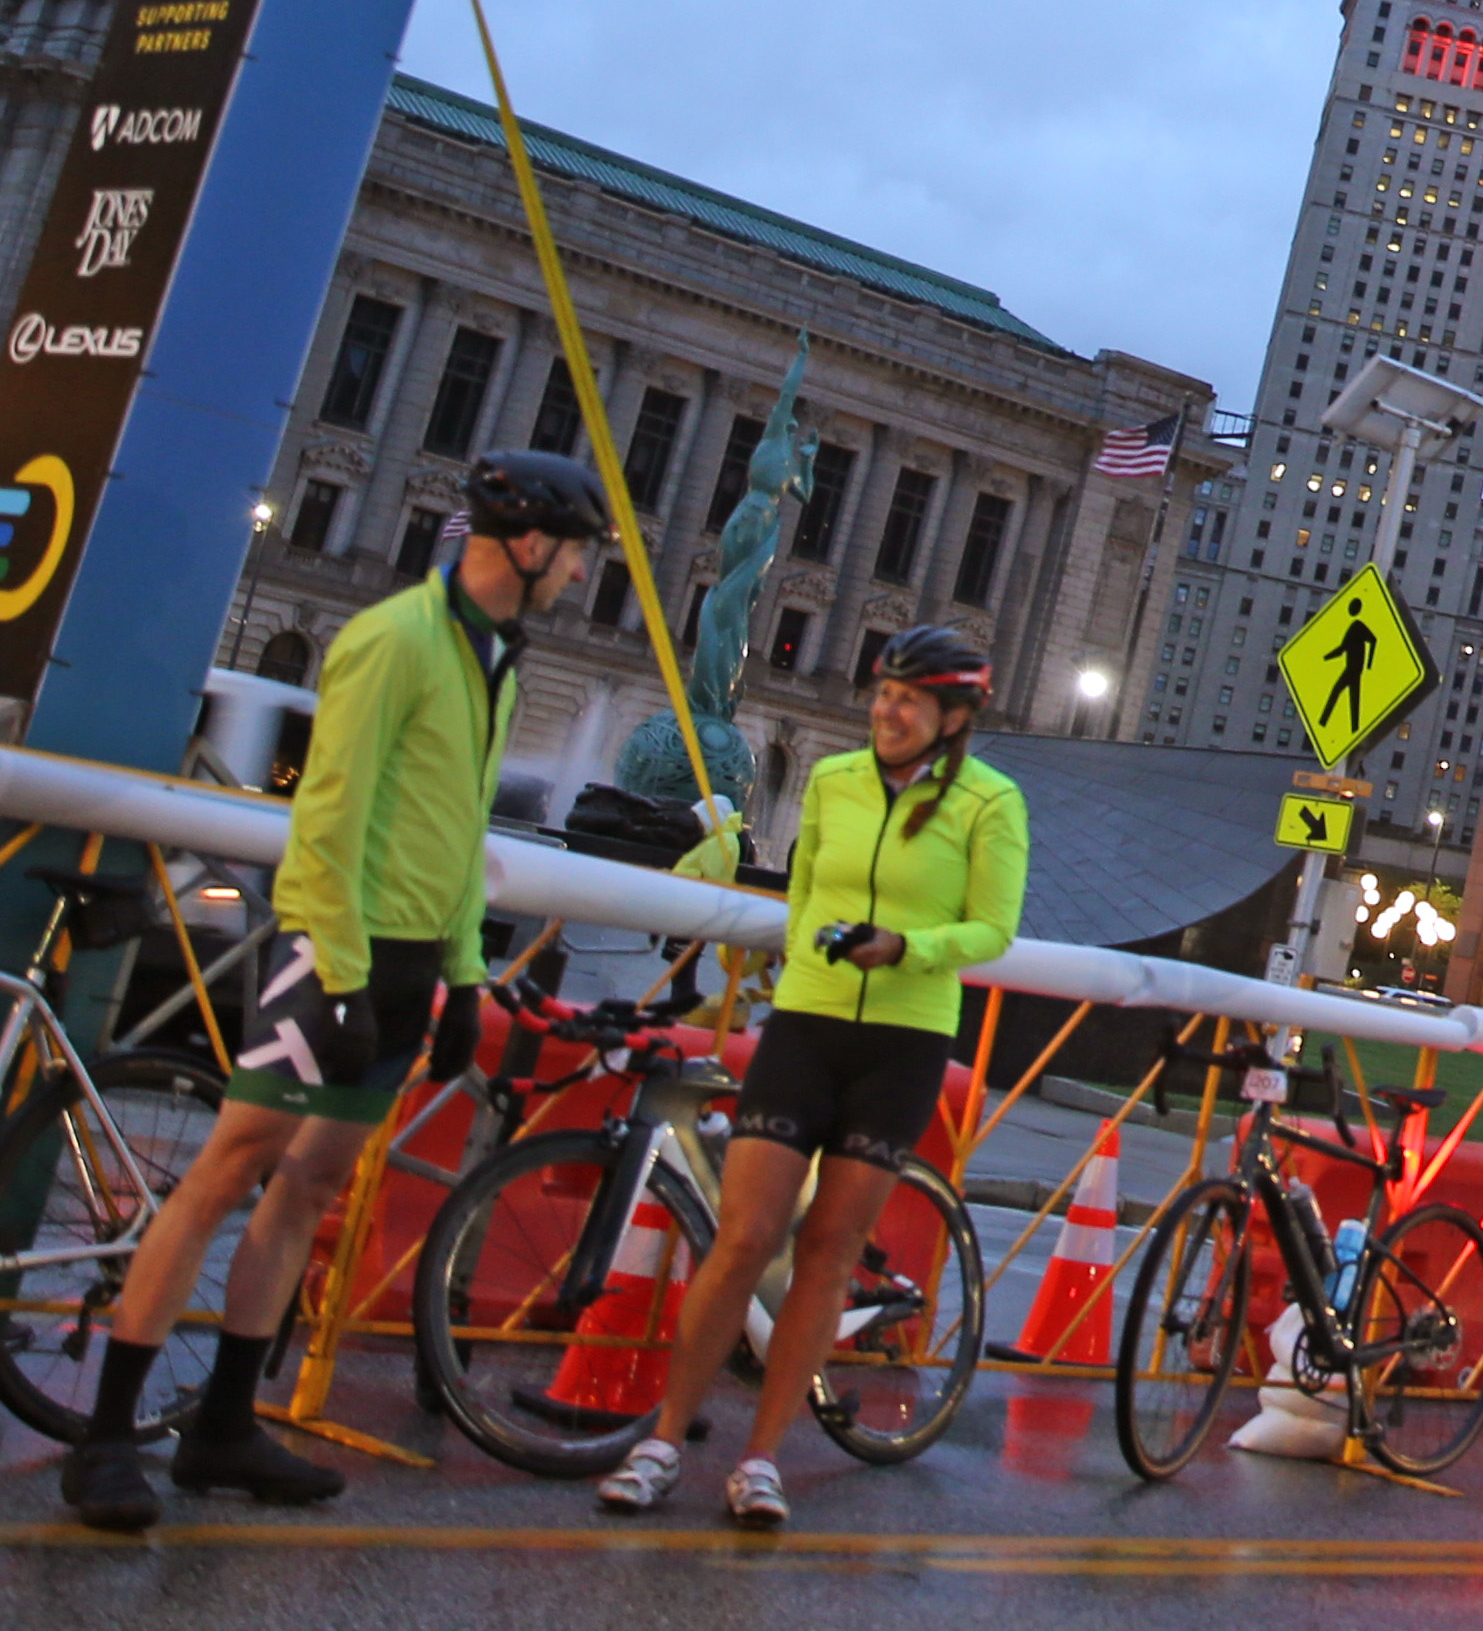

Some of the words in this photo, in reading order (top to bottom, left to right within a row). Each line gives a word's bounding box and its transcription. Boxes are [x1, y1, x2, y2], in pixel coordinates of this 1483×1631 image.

[134, 27, 212, 54] PARTNERS
[115, 107, 203, 145] ADCOM
[74, 188, 155, 250] JONES
[77, 227, 139, 278] DAY
[43, 325, 144, 357] LEXUS
